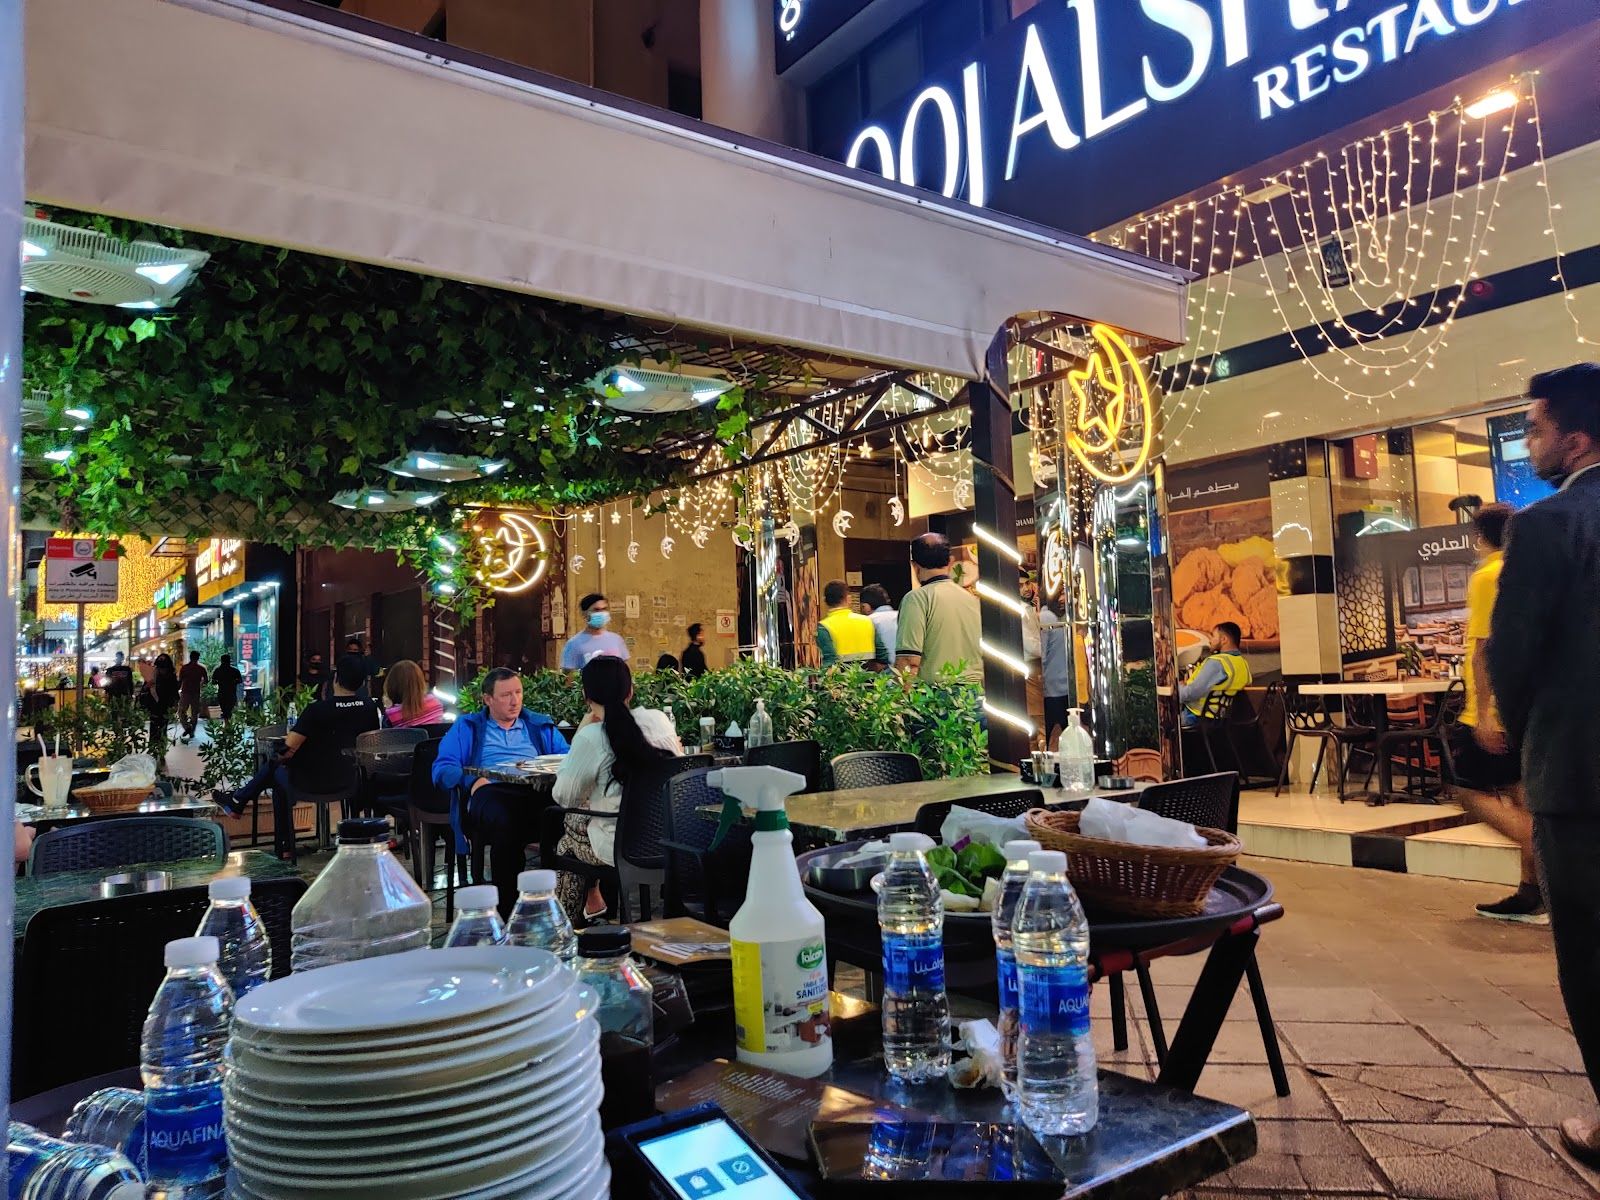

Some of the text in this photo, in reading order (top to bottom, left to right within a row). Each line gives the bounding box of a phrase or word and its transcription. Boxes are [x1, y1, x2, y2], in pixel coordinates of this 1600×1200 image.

[1252, 0, 1525, 120] RESTAU
[1193, 482, 1240, 498] مطعم
[1417, 534, 1470, 560] العلوي
